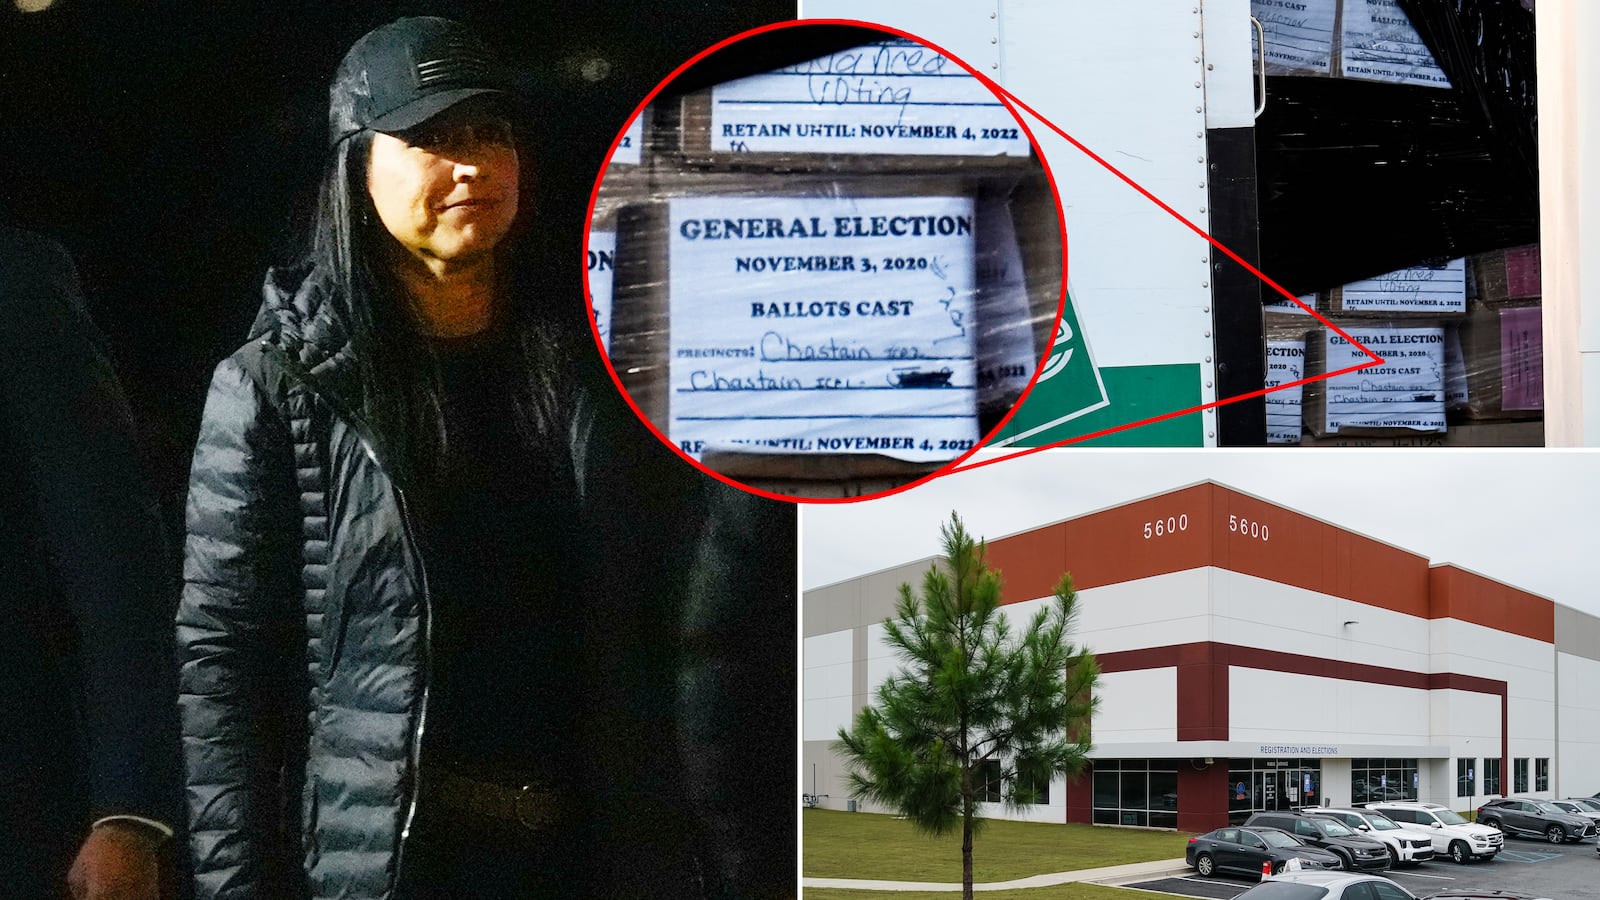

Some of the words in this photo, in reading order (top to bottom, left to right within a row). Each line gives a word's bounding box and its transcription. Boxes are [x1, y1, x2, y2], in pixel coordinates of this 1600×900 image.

[1285, 2, 1307, 11] CAST
[1371, 16, 1407, 26] BALLOTS
[1346, 66, 1372, 75] RETAIN
[1373, 67, 1395, 77] UNTIL:
[1395, 71, 1431, 81] NOVEMBER
[722, 123, 792, 138] RETAIN
[796, 123, 857, 139] UNTIL:
[860, 124, 958, 140] NOVEMBER
[961, 129, 977, 141] 4,
[981, 128, 1019, 140] 2022
[680, 217, 827, 241] GENERAL
[833, 215, 973, 238] ELECTION
[735, 256, 855, 273] NOVEMBER
[861, 258, 878, 273] 3,
[883, 257, 928, 271] 2020
[751, 301, 851, 318] BALLOTS
[856, 300, 914, 317] CAST
[1400, 299, 1438, 307] NOVEMBER
[677, 346, 756, 359] PRECINCTS:
[760, 331, 872, 361] Chastain
[1389, 334, 1444, 345] ELECTION
[1399, 351, 1407, 359] 3,
[1398, 367, 1421, 375] CAST
[690, 370, 802, 391] Chastain
[1361, 379, 1405, 391] Chastain
[1333, 395, 1378, 403] Chastain
[817, 438, 915, 450] NOVEMBER
[919, 439, 934, 451] 4,
[939, 439, 974, 451] 2022
[1144, 514, 1188, 539] 5600
[1229, 514, 1269, 542] 5600
[1260, 746, 1299, 754] REGISTRATION
